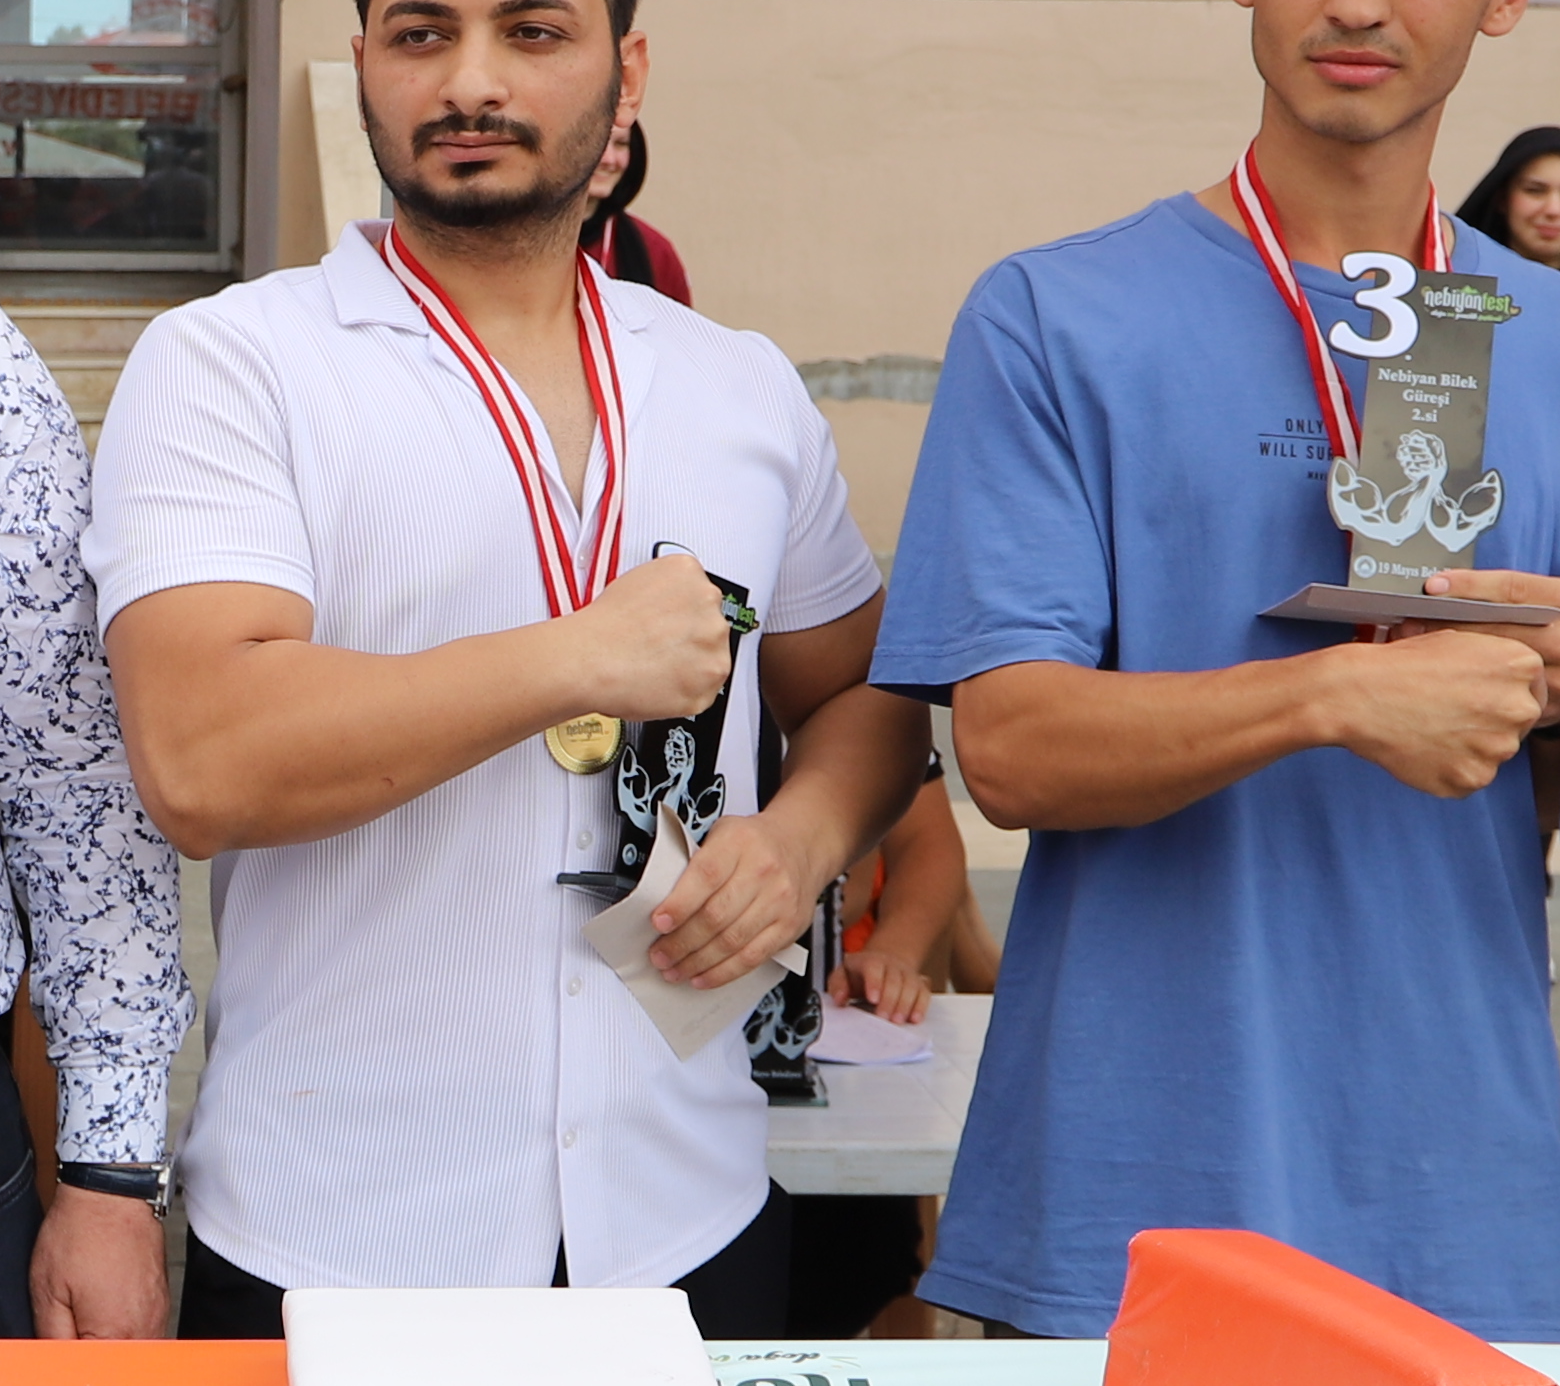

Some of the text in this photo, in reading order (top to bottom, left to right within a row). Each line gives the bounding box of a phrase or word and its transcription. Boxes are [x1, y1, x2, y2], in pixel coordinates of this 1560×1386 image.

[1377, 367, 1478, 390] Nebiyan Bilek
[1402, 388, 1451, 408] Güreşi
[1411, 408, 1438, 424] 2.si
[1285, 418, 1324, 434] ONLY
[1259, 442, 1297, 458] WILL
